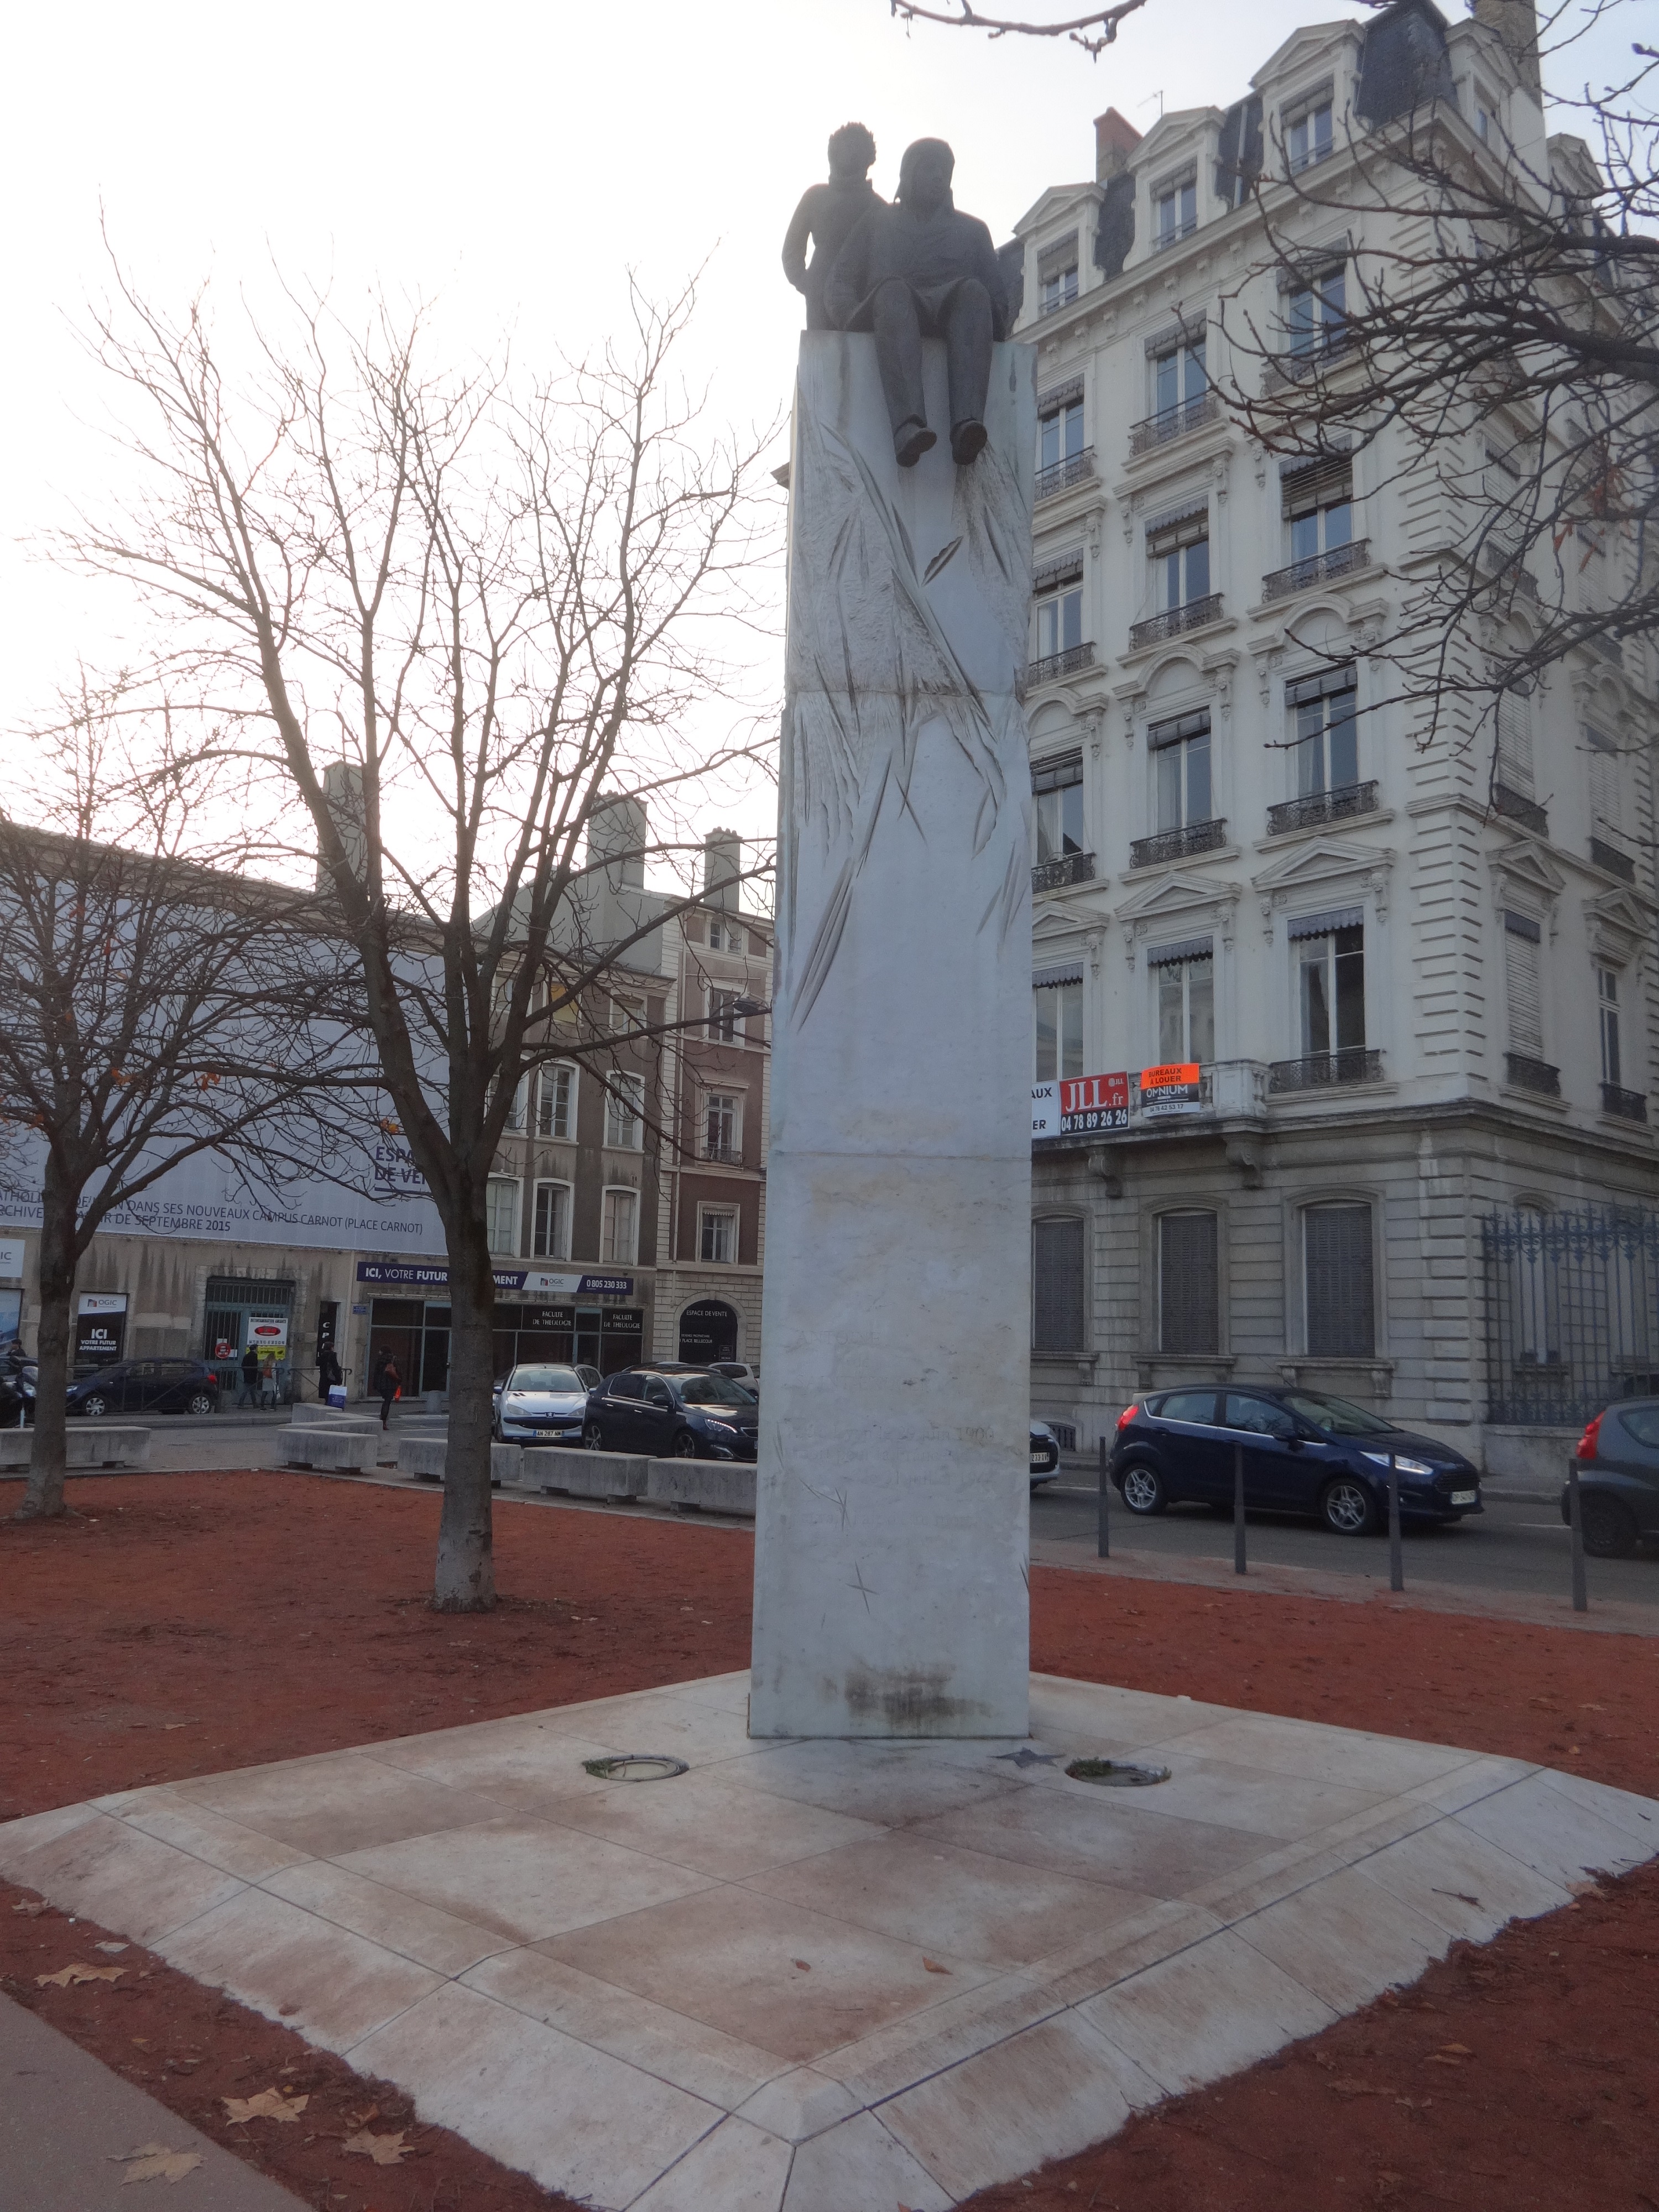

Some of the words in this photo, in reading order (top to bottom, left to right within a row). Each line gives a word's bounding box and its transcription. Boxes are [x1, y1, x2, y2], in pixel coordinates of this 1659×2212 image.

[1149, 1068, 1182, 1077] BUREAUX
[1156, 1076, 1181, 1084] LOUER
[1061, 1116, 1071, 1131] 04
[1074, 1114, 1084, 1129] 78
[1086, 1113, 1098, 1128] 89
[1100, 1110, 1112, 1126] 26
[1115, 1109, 1127, 1125] 26
[116, 1213, 131, 1224] DE
[135, 1215, 202, 1229] SEPTEMBRE
[205, 1219, 231, 1231] 2015
[127, 1200, 159, 1213] DANS
[163, 1203, 183, 1214] SES
[186, 1205, 249, 1220] NOUVEAUX
[301, 1214, 343, 1227] CARNOT
[345, 1218, 378, 1230] (PLACE
[381, 1220, 422, 1235] CARNOT)
[366, 1267, 382, 1279] ICI,
[385, 1269, 414, 1279] VOTRE
[416, 1271, 447, 1281] FUTUR
[586, 1279, 591, 1287] 0
[591, 1280, 603, 1288] 805
[603, 1280, 615, 1288] 230
[91, 1329, 107, 1339] ICI
